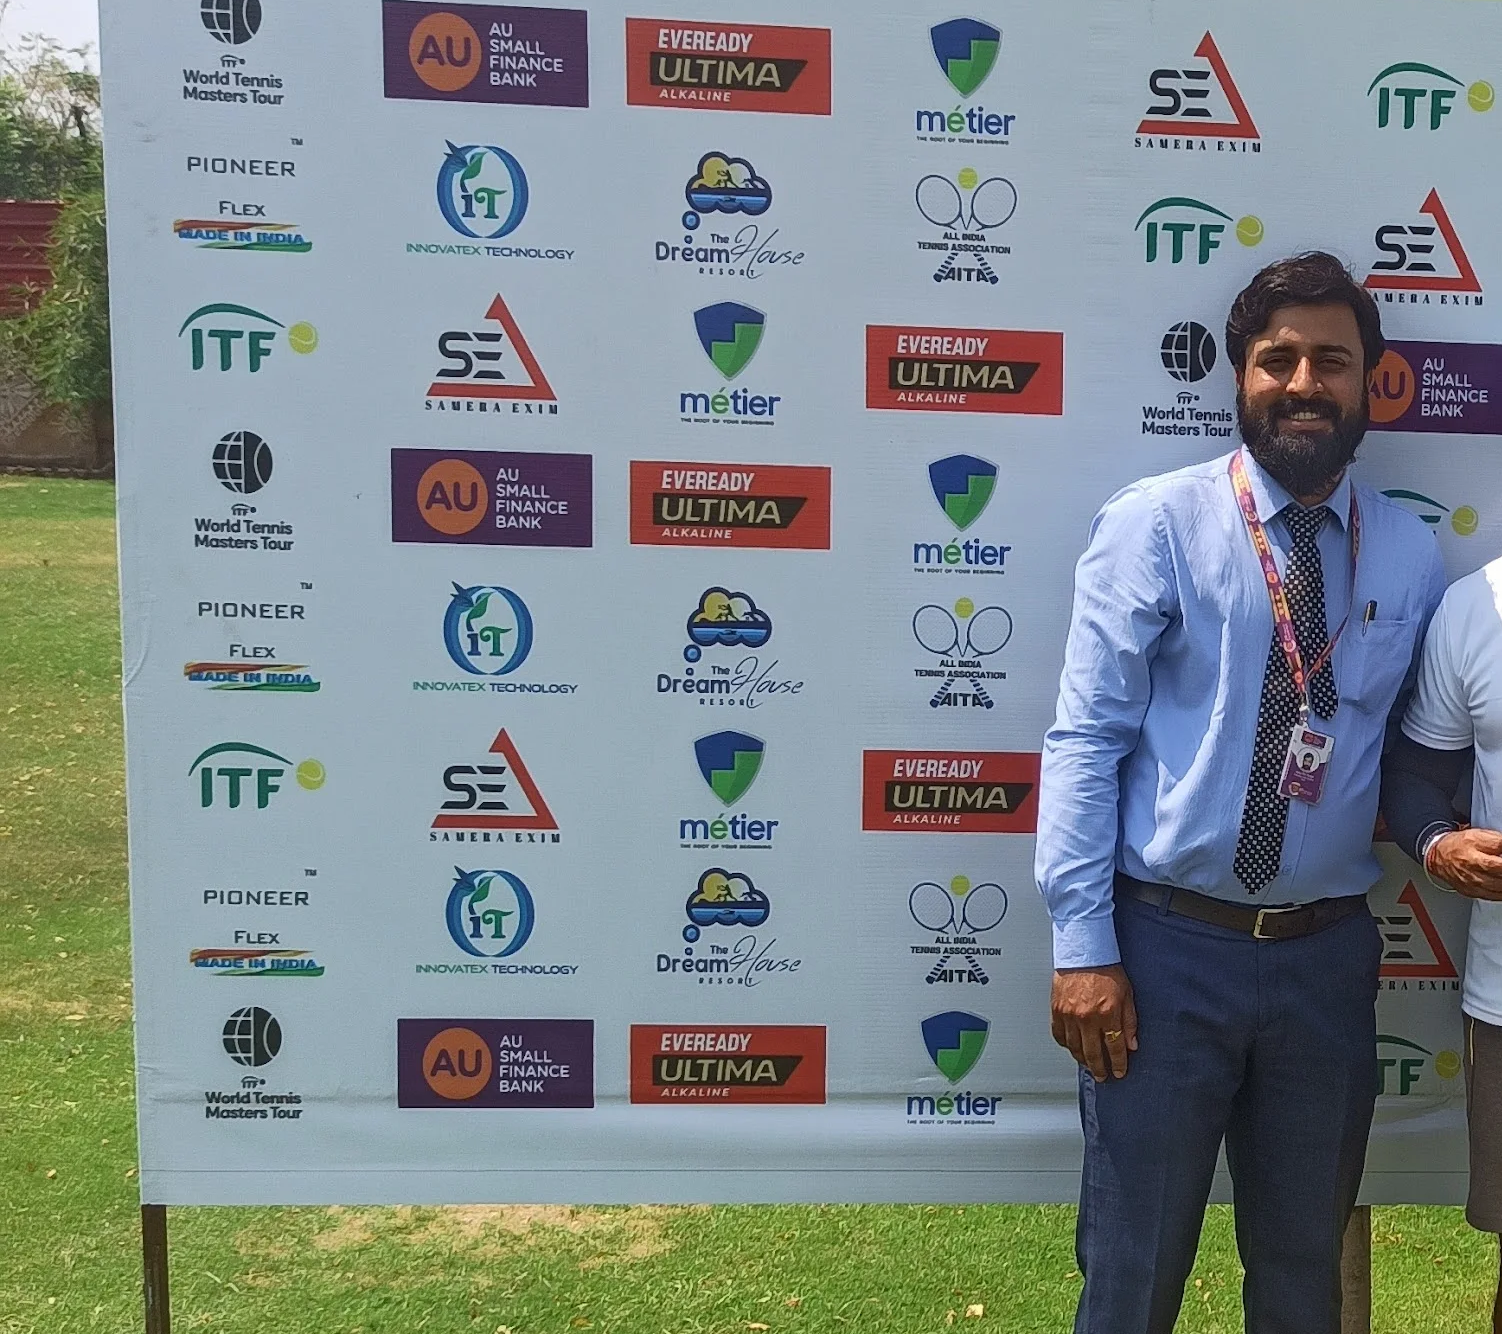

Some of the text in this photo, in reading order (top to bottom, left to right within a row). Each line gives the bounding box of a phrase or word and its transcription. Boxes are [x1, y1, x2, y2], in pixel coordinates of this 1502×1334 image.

[489, 23, 512, 37] AU
[490, 39, 545, 55] SMALL
[659, 29, 753, 52] EVEREADY
[490, 55, 563, 73] FINANCE
[183, 69, 283, 88] World Tennis
[490, 72, 536, 87] BANK
[659, 59, 780, 88] ULTIMA
[184, 86, 284, 105] Masters Tour
[659, 89, 731, 101] ALKALINE
[1378, 87, 1456, 130] ITF
[917, 105, 1015, 135] métier
[1218, 141, 1260, 152] EXIM
[188, 157, 295, 177] PIONEER
[219, 201, 266, 216] FLEX
[180, 229, 303, 246] MADE IN INDIA
[710, 234, 729, 243] The
[943, 232, 985, 241] ALL INDIA
[1146, 222, 1225, 265] ITF
[407, 243, 574, 259] INNOVATEX TECHNOLOGY
[655, 224, 805, 279] Dream House
[917, 242, 1010, 256] TENNIS ASSOCIATION
[699, 268, 755, 277] RESORT
[943, 268, 989, 283] AITA
[1441, 295, 1482, 305] EXIM
[191, 328, 276, 372] ITF
[512, 403, 557, 414] EXIM
[681, 387, 781, 416] métier
[914, 538, 1011, 565] métier
[199, 602, 304, 619] PIONEER
[230, 644, 275, 658] FLEX
[958, 660, 981, 668] INDIA
[914, 669, 1006, 679] TENNIS ASSOCIATION
[940, 692, 983, 708] AITA
[894, 759, 983, 778] EVEREADY
[893, 785, 1008, 808] ULTIMA
[680, 813, 778, 840] métier
[893, 815, 961, 824] ALKALINE
[1419, 981, 1459, 991] EXIM
[500, 1035, 522, 1048] AU
[500, 1049, 552, 1062] SMALL
[500, 1065, 569, 1077] FINANCE
[500, 1080, 544, 1092] BANK
[907, 1091, 1005, 1115] métier
